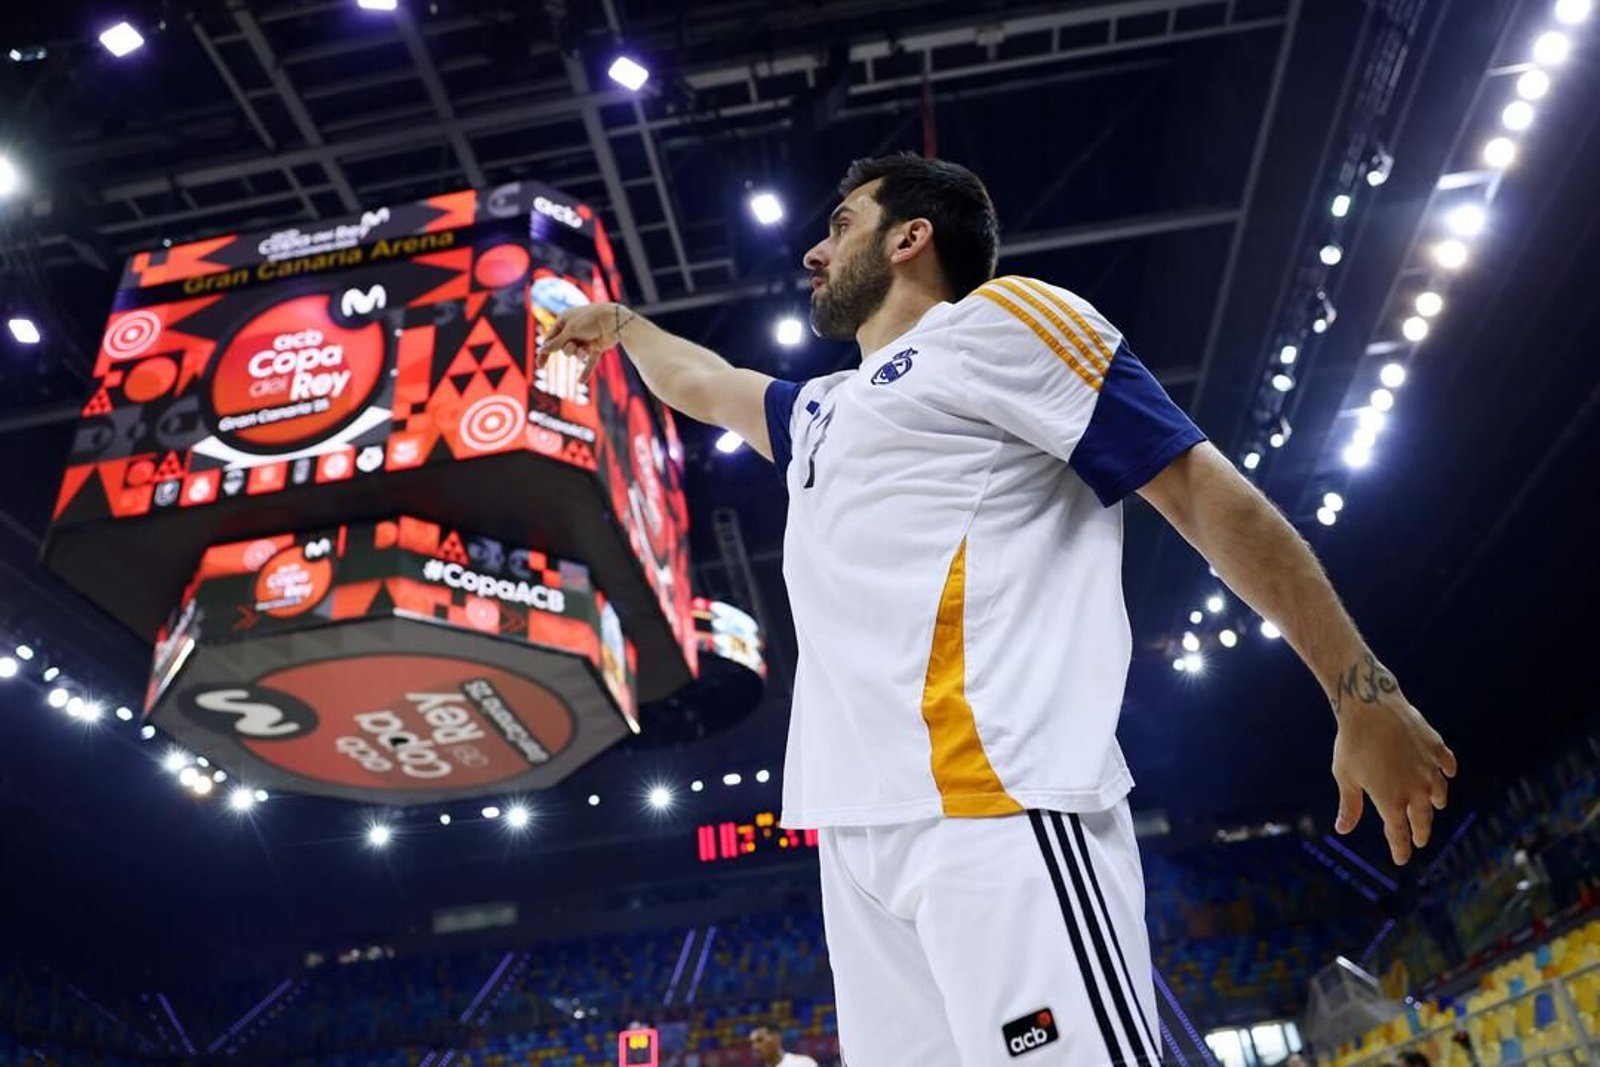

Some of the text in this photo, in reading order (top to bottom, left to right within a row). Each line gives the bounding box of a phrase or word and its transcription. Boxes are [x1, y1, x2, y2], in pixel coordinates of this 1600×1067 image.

[533, 196, 583, 229] acb
[183, 266, 248, 295] Gran
[256, 245, 363, 281] Canaria
[369, 229, 456, 261] Arena
[272, 328, 325, 352] acb
[248, 344, 345, 380] Copa
[289, 369, 351, 402] Rey
[422, 558, 566, 614] #CopaACB
[404, 691, 486, 745] Rey
[354, 709, 453, 779] Copa
[1010, 1026, 1049, 1053] acb
